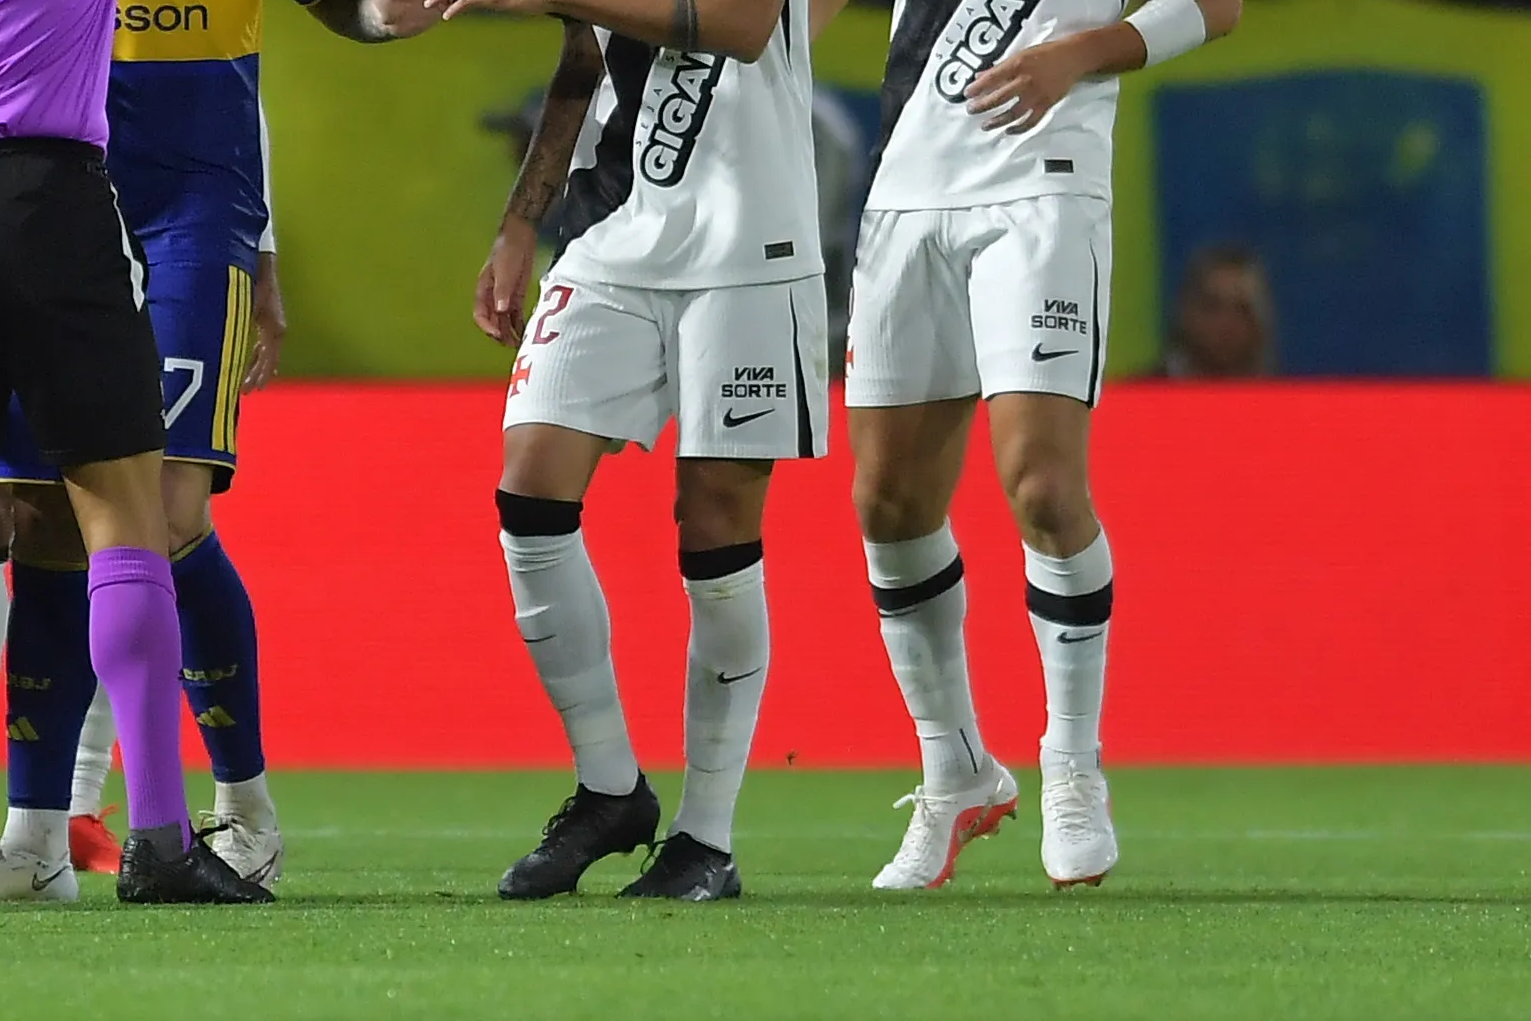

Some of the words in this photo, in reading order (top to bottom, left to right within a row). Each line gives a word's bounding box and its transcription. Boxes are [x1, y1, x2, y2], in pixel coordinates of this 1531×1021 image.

[1044, 299, 1078, 316] VIVA
[1031, 315, 1087, 334] SORTE
[734, 367, 774, 381] VIVA
[163, 357, 203, 429] 7
[721, 384, 786, 398] SORTE
